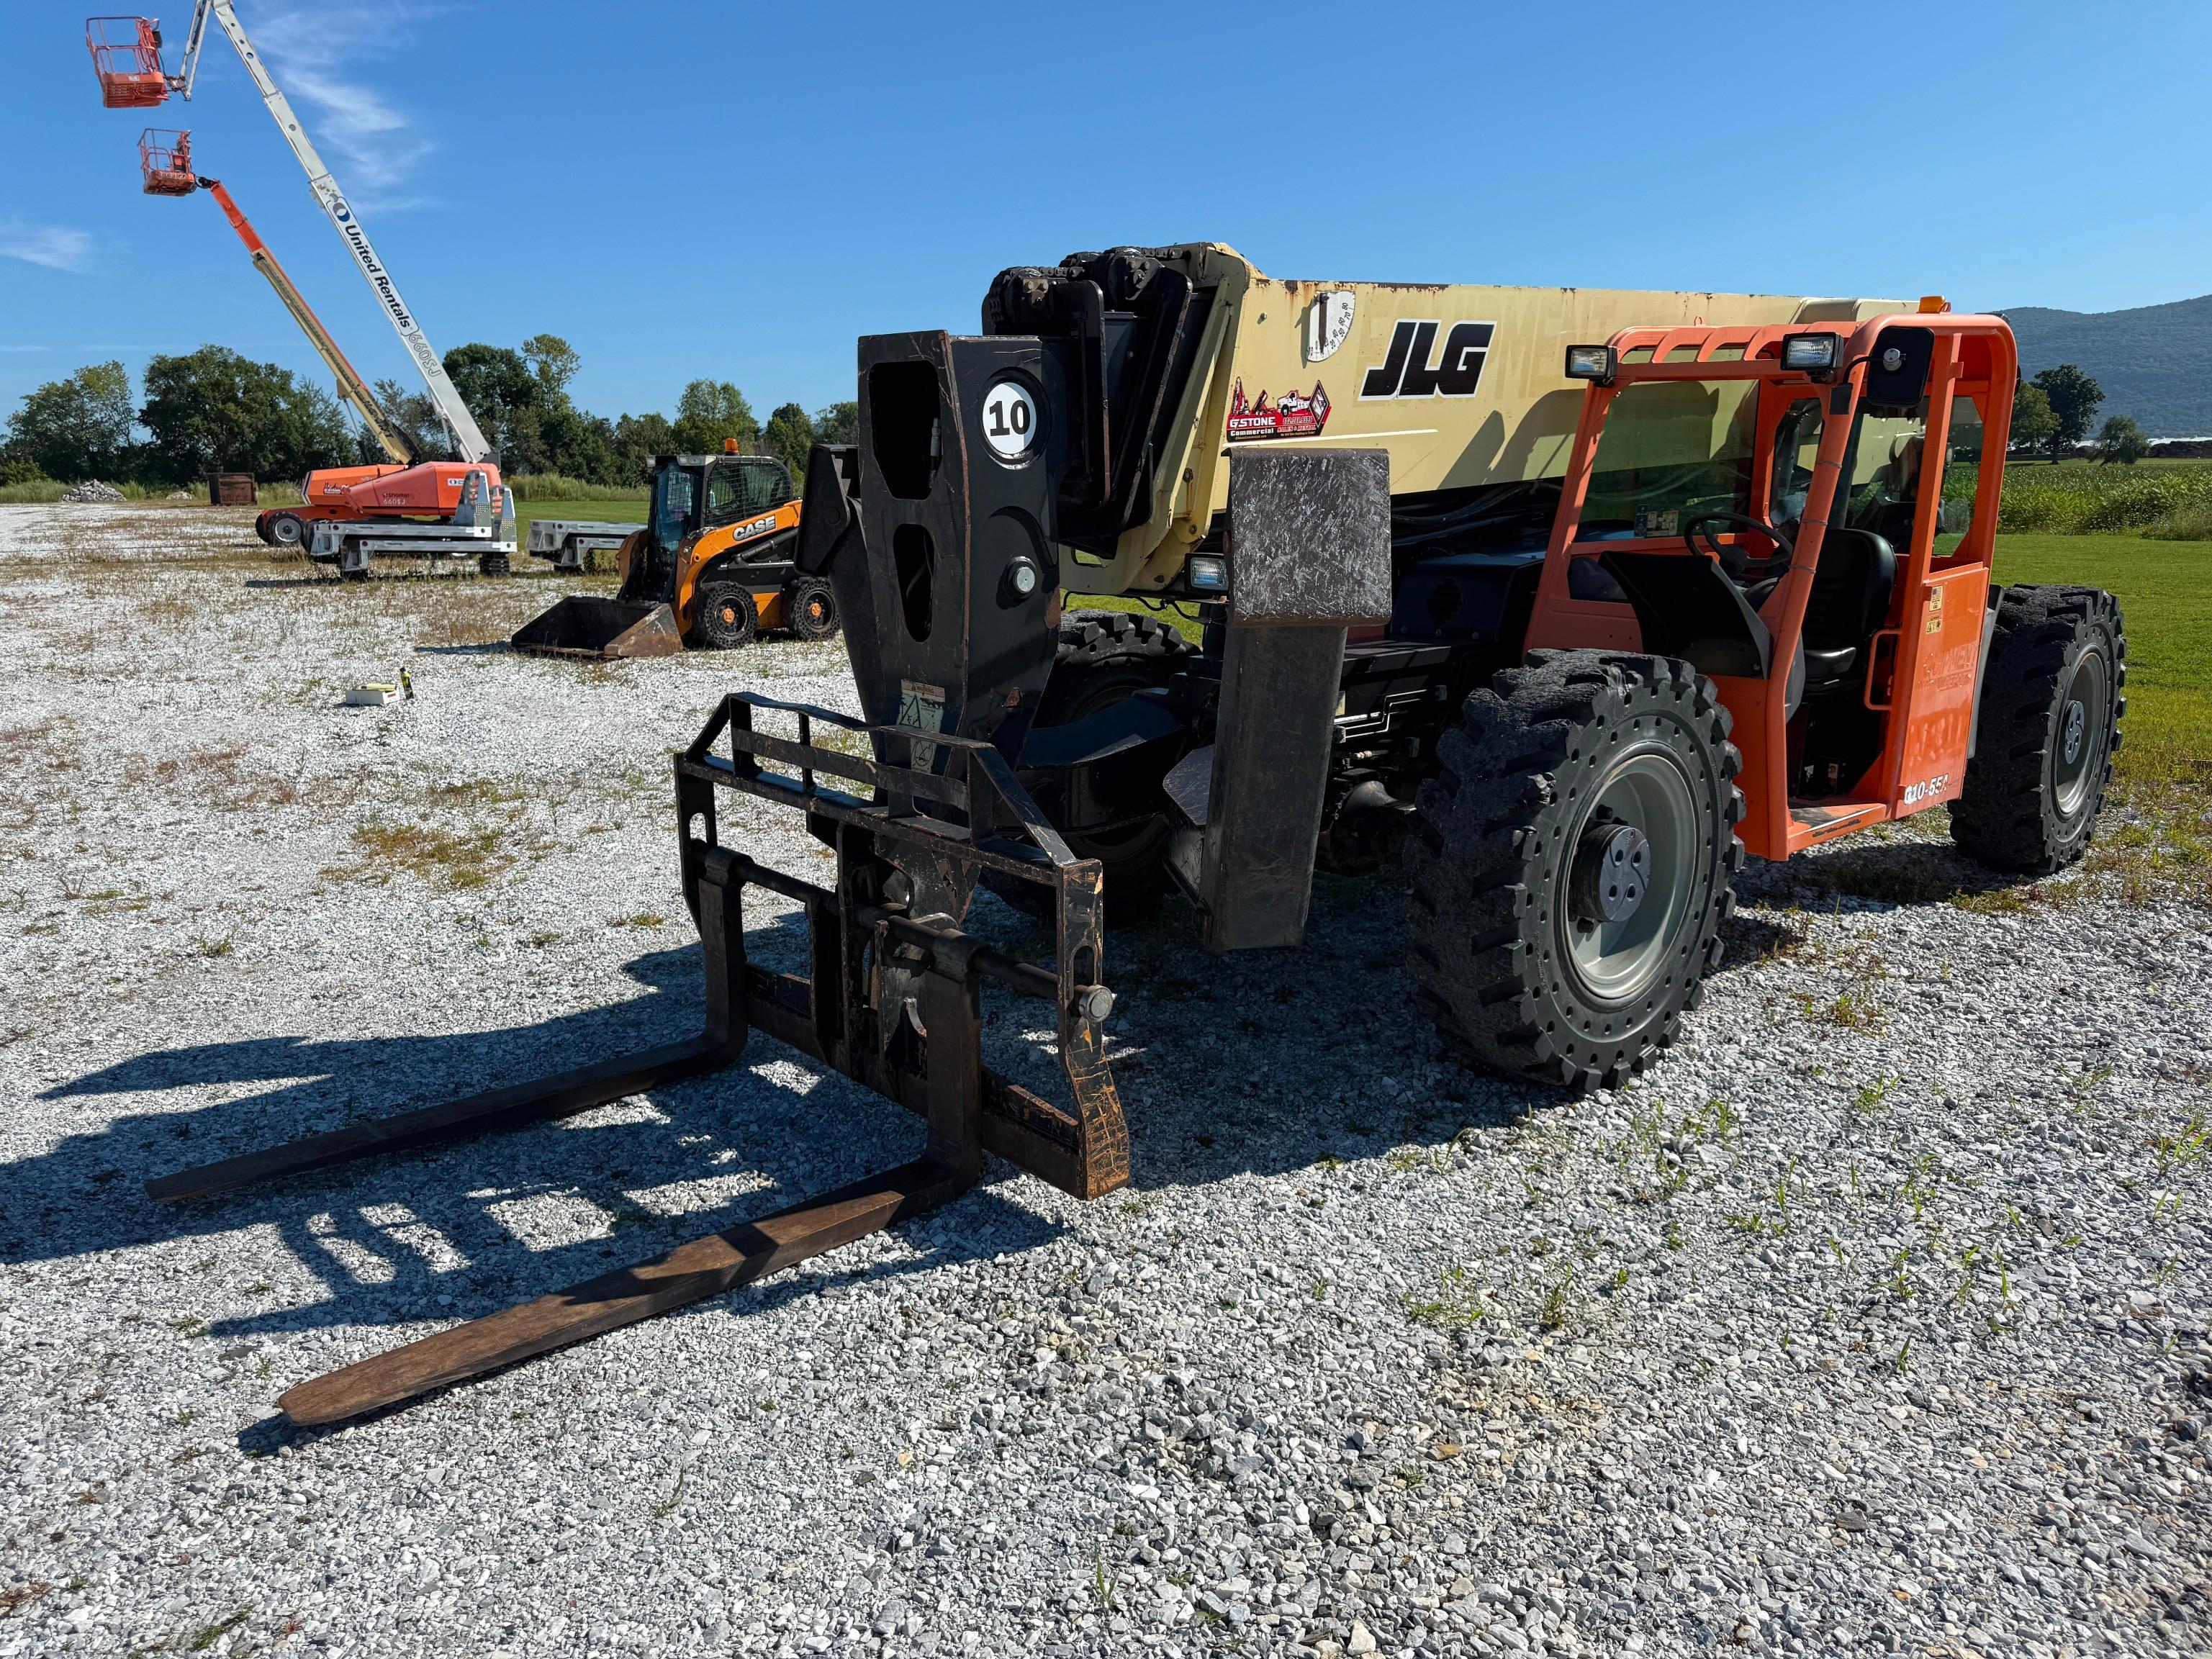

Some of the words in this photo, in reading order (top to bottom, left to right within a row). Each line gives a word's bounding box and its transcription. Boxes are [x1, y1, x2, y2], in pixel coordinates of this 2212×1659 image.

[345, 225, 382, 273] United
[374, 276, 411, 328] Rentals
[1338, 317, 1345, 326] 60
[1344, 312, 1350, 320] 70
[1338, 328, 1345, 338] 50
[409, 334, 441, 377] 660SJ
[1358, 320, 1497, 401] JLG
[989, 399, 1031, 437] 10
[1230, 428, 1274, 437] Commercial
[733, 515, 775, 541] CASE
